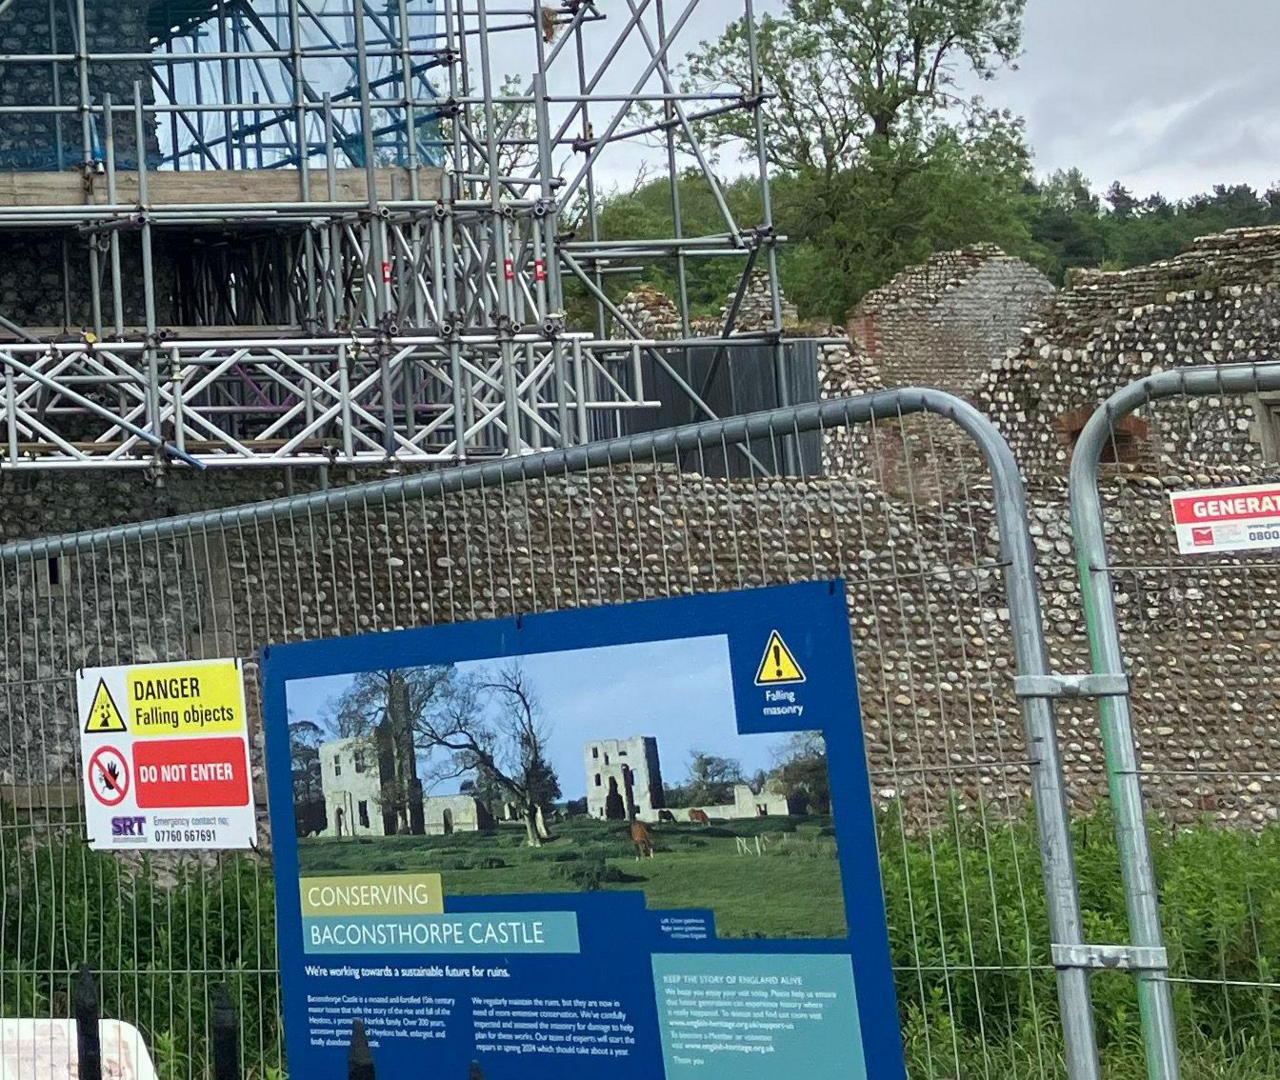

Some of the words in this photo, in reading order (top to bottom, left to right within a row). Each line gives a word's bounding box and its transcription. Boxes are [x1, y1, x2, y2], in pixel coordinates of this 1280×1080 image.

[134, 677, 201, 701] DANGER
[766, 690, 796, 703] Falling
[136, 706, 179, 728] Falling
[184, 704, 234, 727] objects
[763, 705, 804, 717] masonry
[140, 765, 158, 783] DO
[161, 764, 187, 782] NOT
[191, 763, 233, 782] ENTER
[111, 816, 147, 836] SRT
[153, 816, 190, 828] Emergency
[191, 817, 217, 826] contact
[155, 830, 182, 842] 07760
[184, 829, 216, 842] 667691
[308, 883, 429, 907] CONSERVING
[310, 922, 464, 946] BACONSTHORPE
[468, 921, 546, 944] CASTLE
[305, 965, 329, 977] We're
[329, 965, 361, 980] working
[361, 965, 393, 977] towards
[394, 968, 400, 977] a
[401, 965, 444, 978] sustainable
[445, 965, 471, 978] future
[472, 965, 484, 977] for
[487, 966, 511, 978] ruins.
